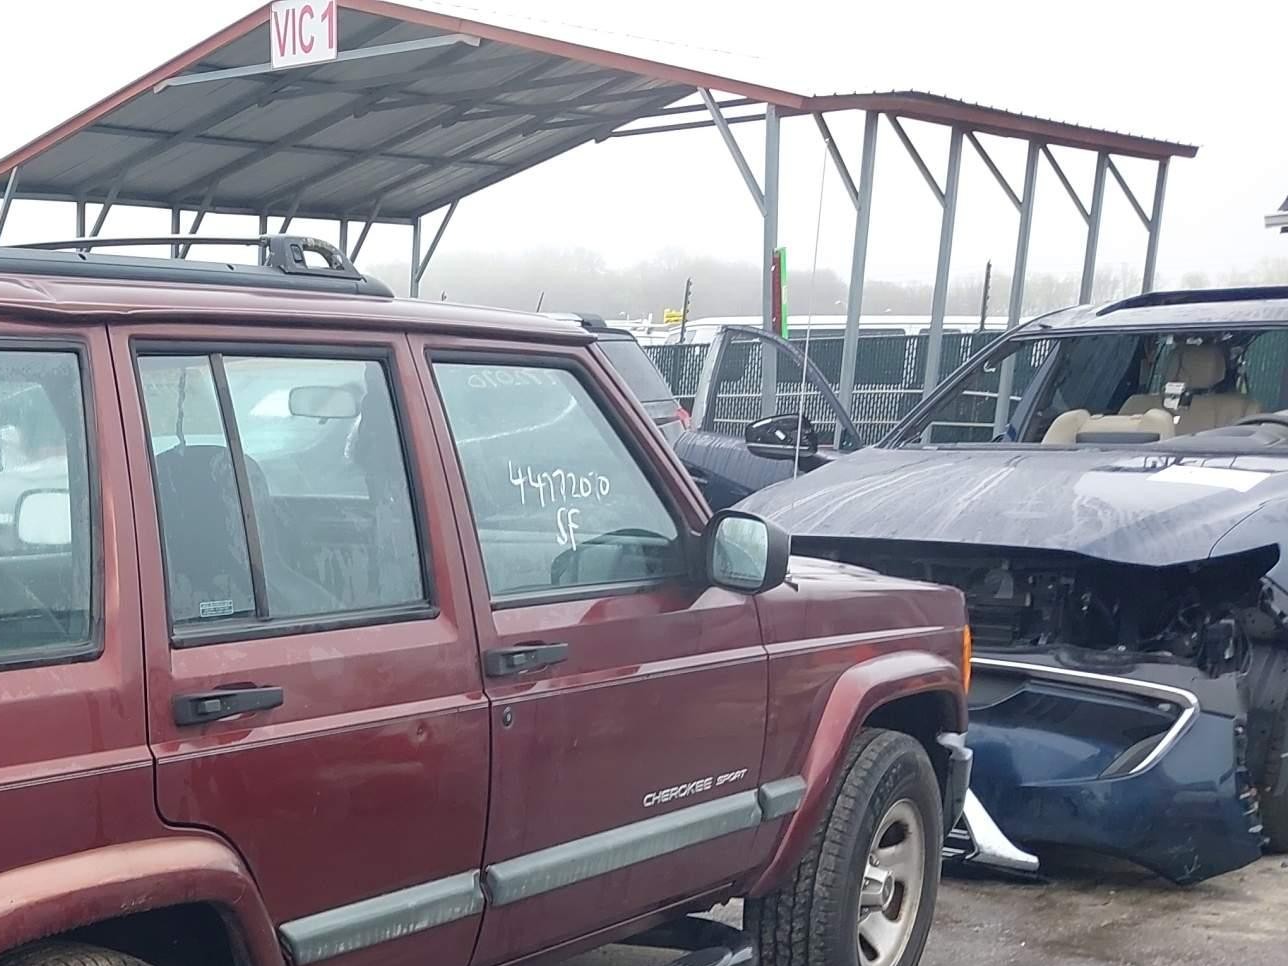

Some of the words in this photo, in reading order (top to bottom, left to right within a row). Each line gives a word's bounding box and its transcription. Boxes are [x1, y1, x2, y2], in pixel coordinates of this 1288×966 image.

[273, 4, 315, 57] VIC
[320, 1, 334, 49] 1
[556, 506, 581, 552] SF
[642, 776, 714, 808] CHEROKEE
[715, 768, 748, 786] SPORT
